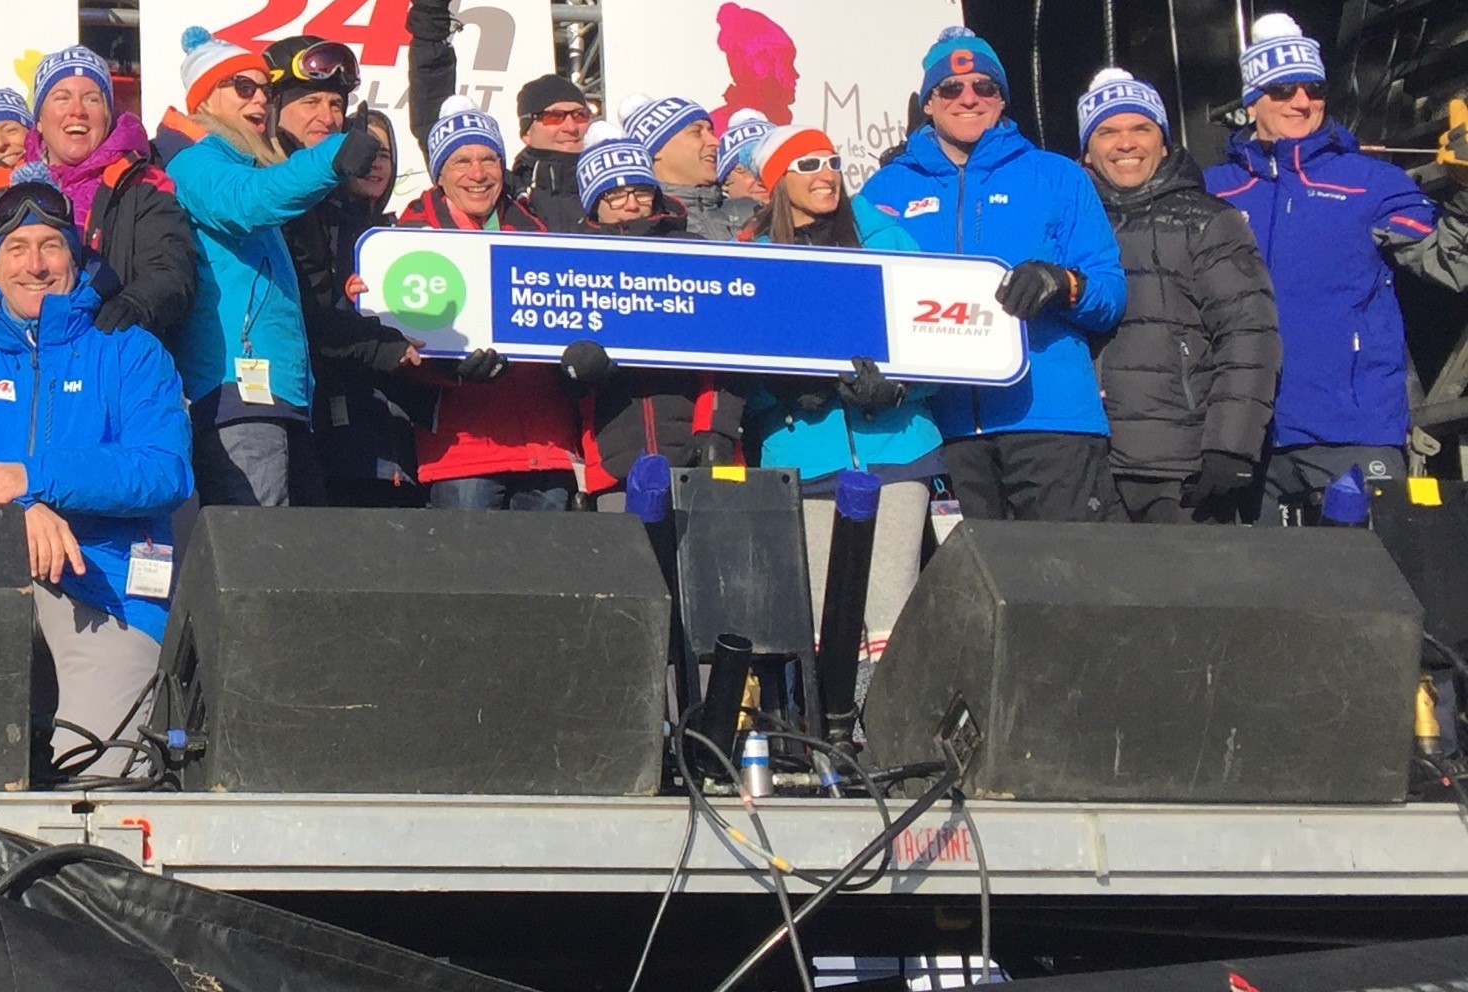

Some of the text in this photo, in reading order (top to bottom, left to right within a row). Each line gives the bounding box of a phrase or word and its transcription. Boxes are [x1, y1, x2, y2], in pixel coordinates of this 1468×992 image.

[822, 81, 907, 150] Moti
[401, 273, 448, 309] 3e
[511, 266, 756, 297] Les vieux bambous de
[511, 287, 695, 315] Morin Height-ski
[912, 300, 994, 327] 24h
[510, 308, 604, 332] 49 042 $
[912, 324, 991, 337] TREMBLANT
